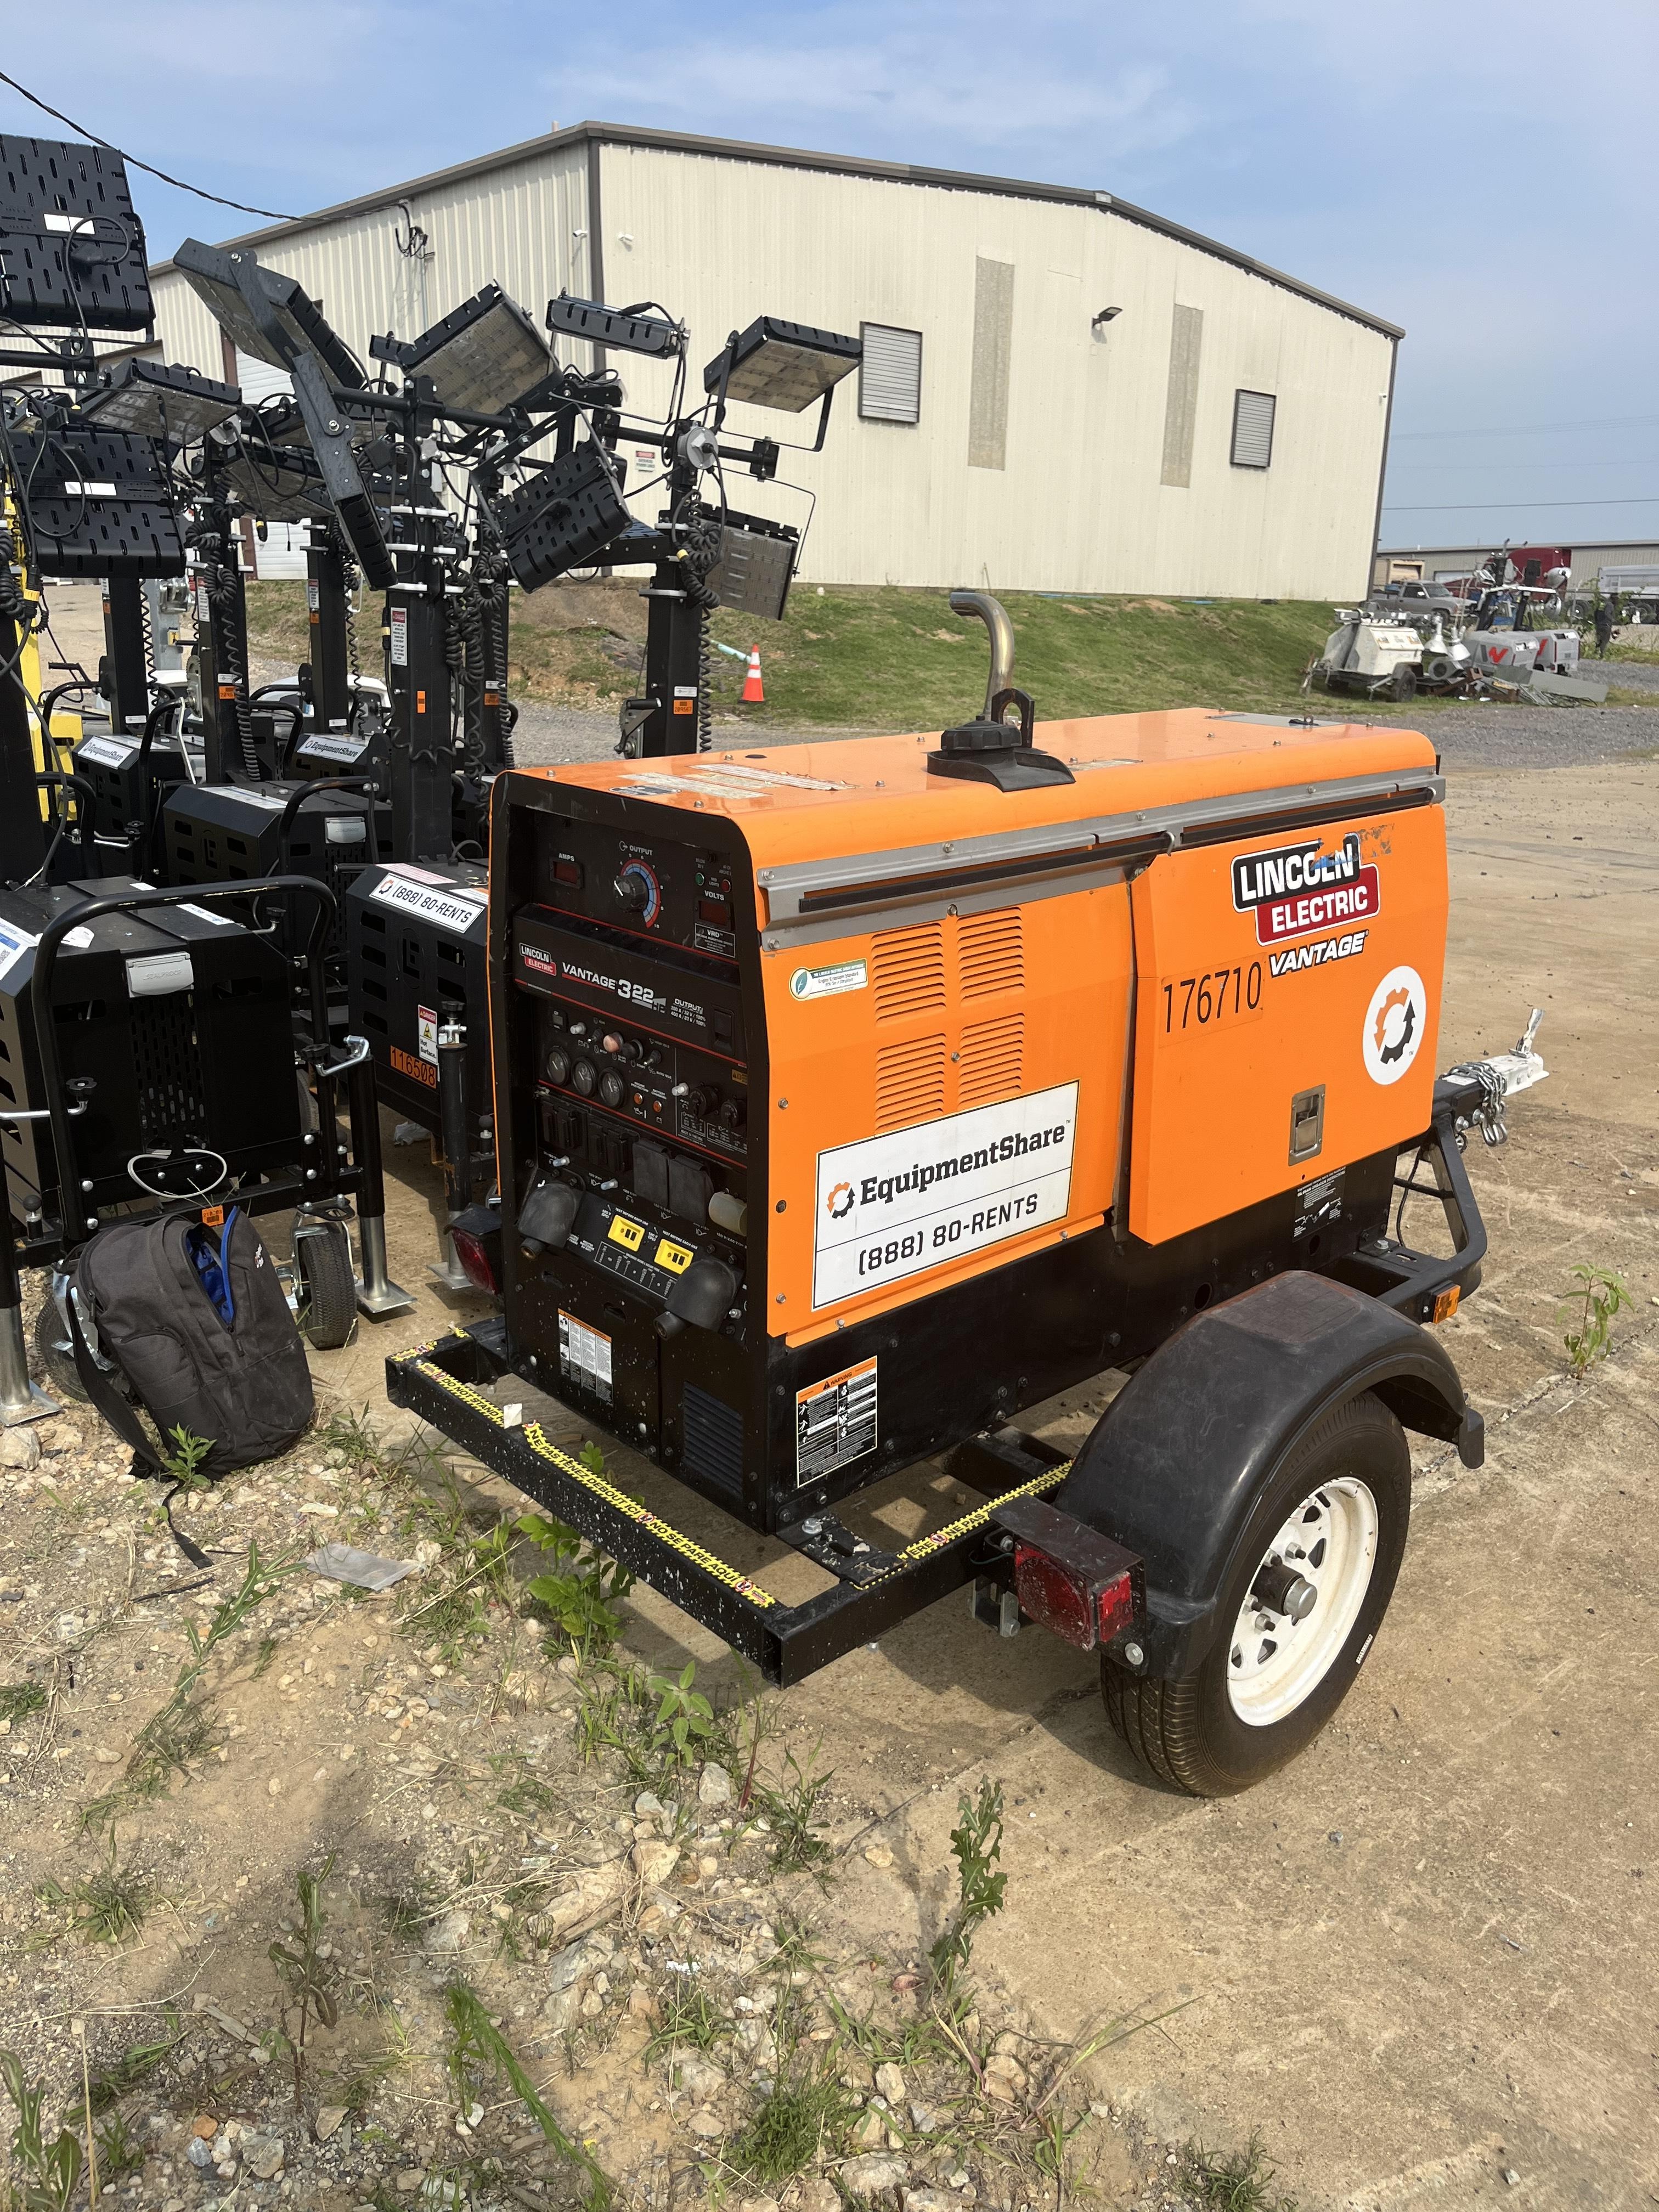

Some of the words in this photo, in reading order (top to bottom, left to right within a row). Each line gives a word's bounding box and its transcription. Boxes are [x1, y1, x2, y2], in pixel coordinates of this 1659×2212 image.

[311, 742, 358, 757] EquipmentShare
[558, 853, 574, 862] AMPS
[629, 845, 653, 856] OUTPUT
[392, 885, 423, 905] (888)
[420, 897, 472, 923] 80-RENTS
[704, 890, 725, 901] VOLTS
[1271, 885, 1368, 933] ELECTRIC
[521, 945, 550, 963] LINCOLN
[528, 960, 554, 973] ELECTRIC
[1269, 932, 1365, 978] VANTAGE
[562, 962, 617, 990] VANTAGE
[618, 979, 654, 1003] 322
[1164, 962, 1261, 1033] 176710
[675, 998, 702, 1012] OUTPUT
[392, 1048, 436, 1086] 116508
[860, 1125, 1065, 1205] EquipmentShare
[859, 1231, 923, 1276] (888)
[932, 1193, 1039, 1248] 80-RENTS
[442, 1378, 456, 1387] DO
[455, 1387, 473, 1399] NOT
[470, 1397, 499, 1417] STAND
[830, 1372, 853, 1386] WARNING
[530, 1429, 542, 1447] NE
[541, 1446, 560, 1459] PAS
[560, 1458, 590, 1479] TENEZ
[587, 1477, 628, 1506] DEBOUT
[625, 1503, 641, 1515] ICI
[650, 1522, 668, 1534] NO
[667, 1534, 684, 1544] SE
[681, 1543, 712, 1564] PARE
[945, 1525, 962, 1537] NE
[962, 1513, 985, 1527] PAS
